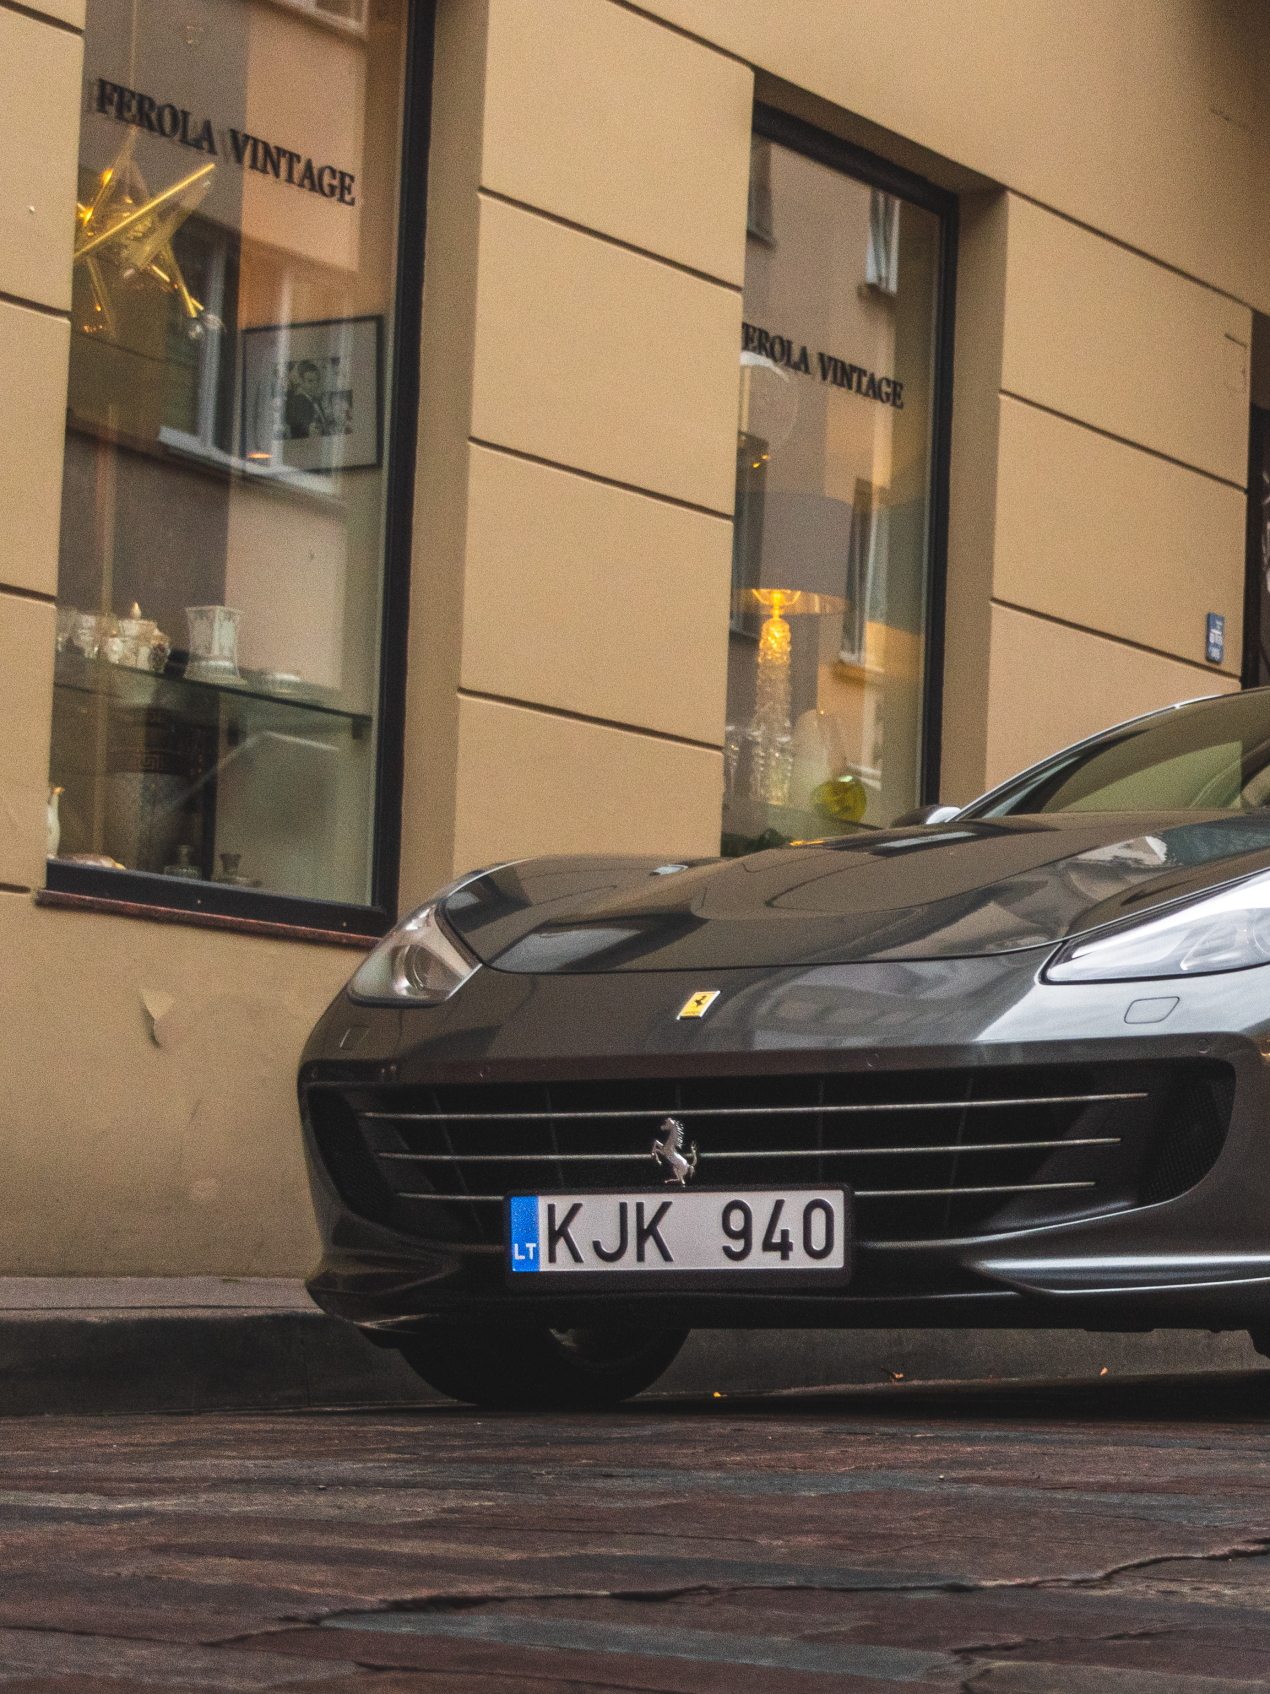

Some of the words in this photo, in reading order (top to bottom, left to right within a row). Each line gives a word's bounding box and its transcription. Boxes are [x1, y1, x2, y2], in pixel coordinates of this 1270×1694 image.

[97, 78, 217, 155] FEROLA
[228, 128, 355, 206] VINTAGE
[742, 321, 811, 375] EROLA
[818, 352, 904, 409] VINTAGE
[513, 1242, 537, 1260] LT
[547, 1201, 674, 1264] KJK
[721, 1198, 835, 1262] 940
